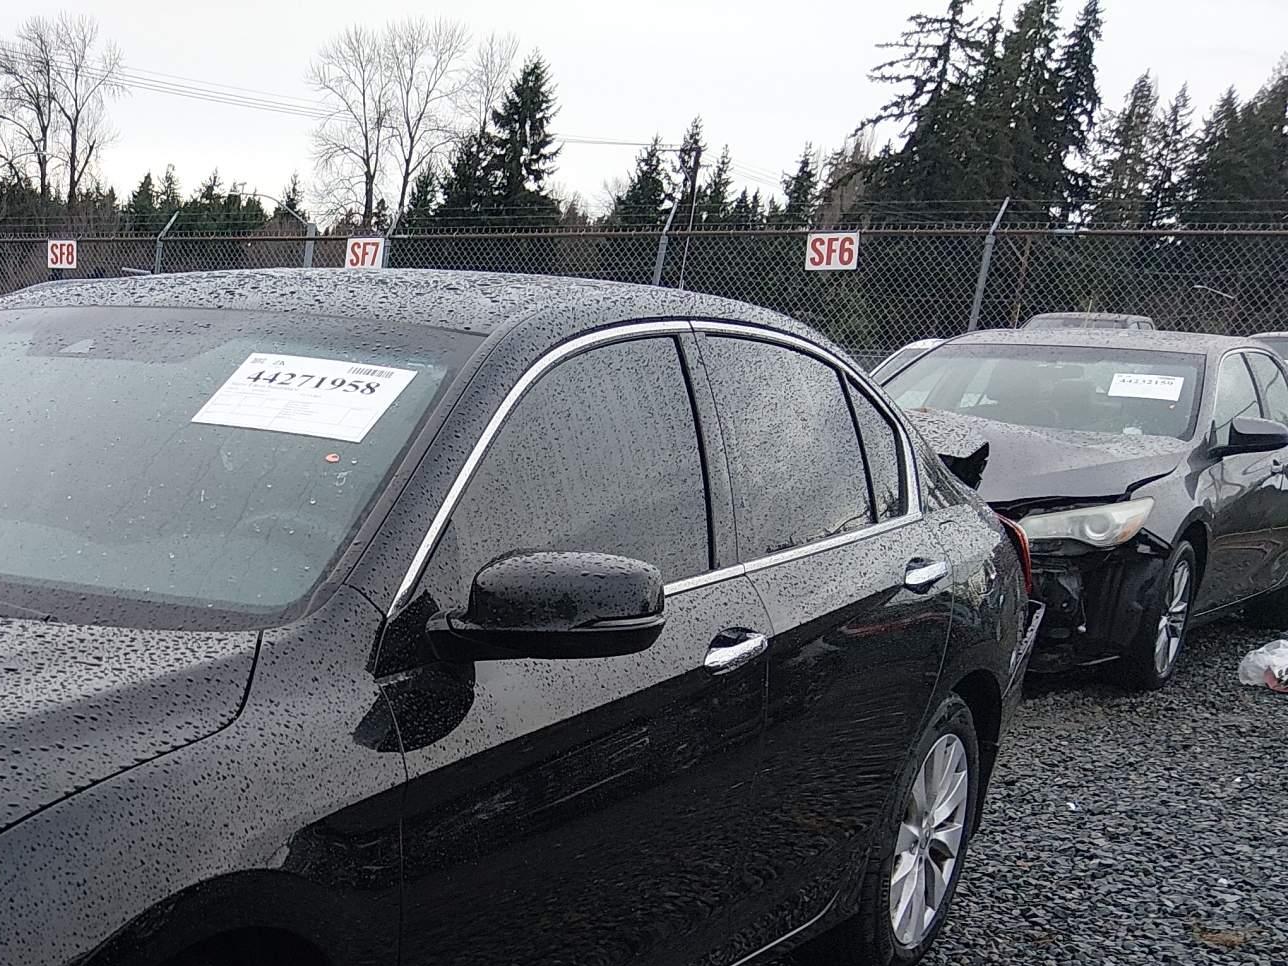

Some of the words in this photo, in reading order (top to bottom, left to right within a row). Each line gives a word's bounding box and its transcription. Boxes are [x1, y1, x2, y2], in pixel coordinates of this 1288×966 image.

[50, 243, 75, 265] SF8
[349, 241, 380, 267] SF7
[809, 236, 855, 267] SF6
[246, 369, 381, 396] 44271958
